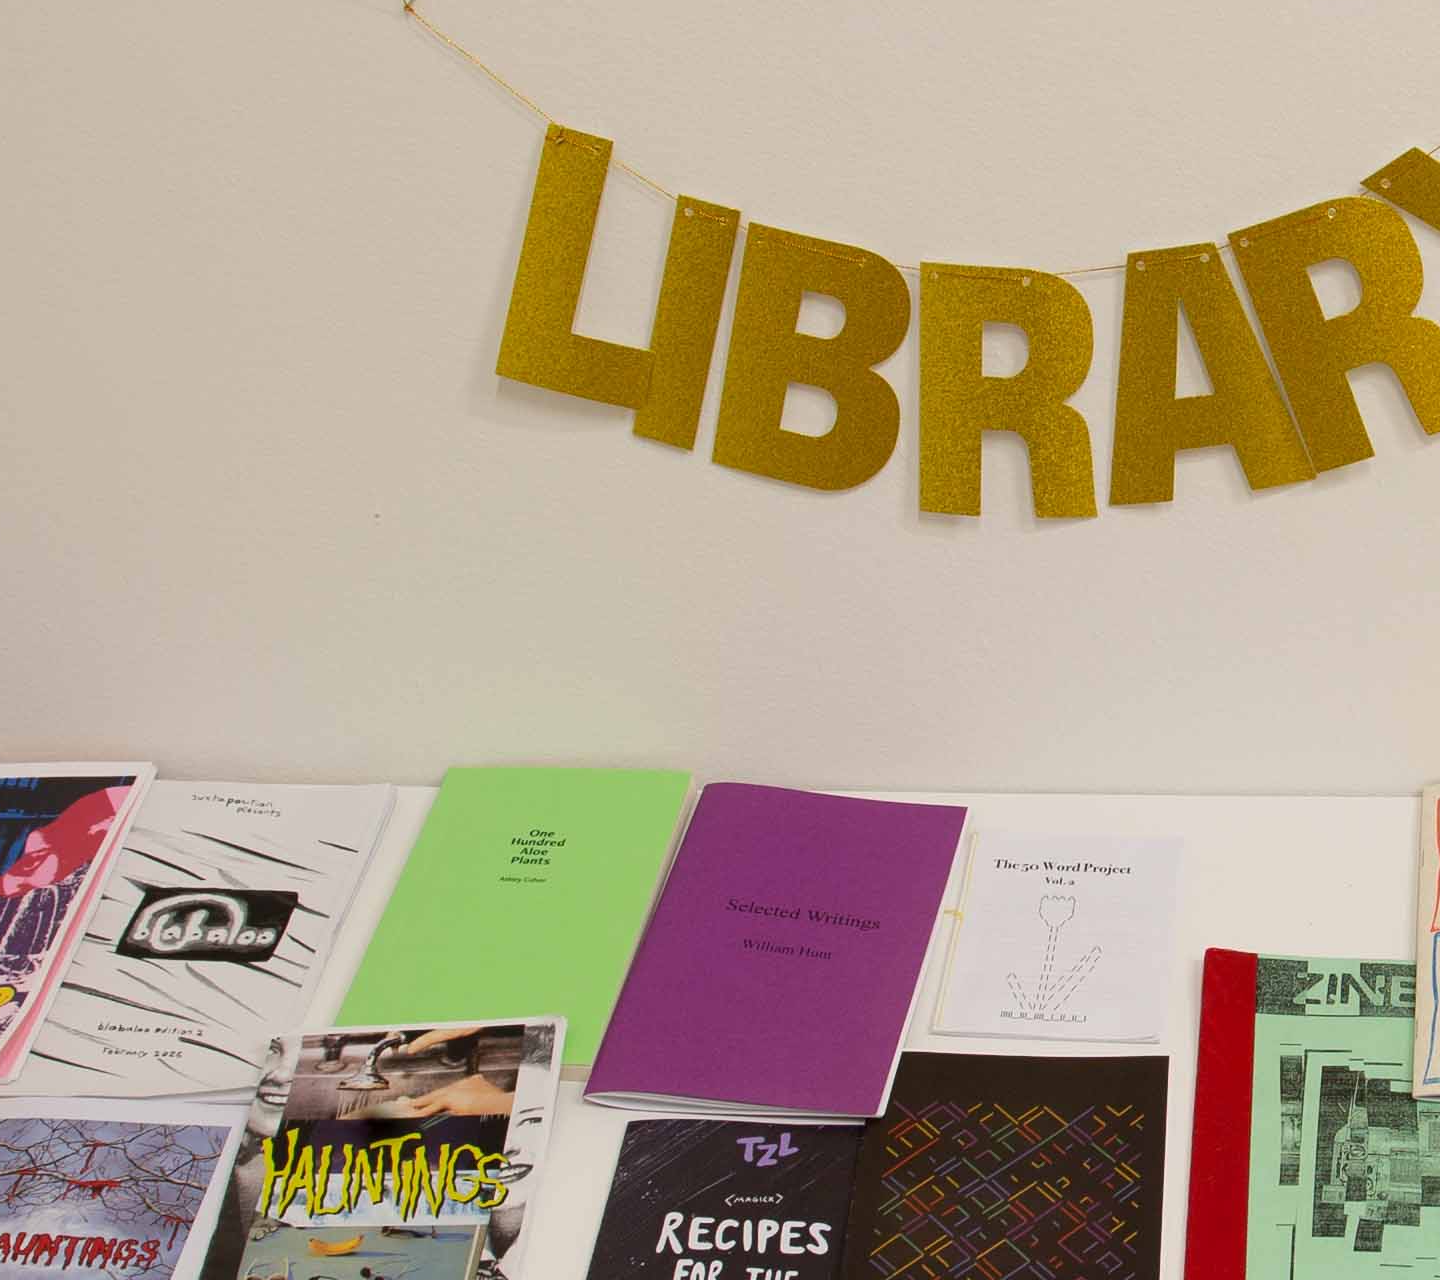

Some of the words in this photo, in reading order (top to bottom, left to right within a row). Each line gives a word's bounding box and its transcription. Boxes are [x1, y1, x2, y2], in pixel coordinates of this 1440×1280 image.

[511, 836, 567, 848] Hundred
[529, 828, 556, 838] One
[511, 855, 551, 866] Plants
[520, 846, 549, 856] Aloe
[994, 858, 1020, 871] The
[1021, 862, 1040, 873] 50
[1043, 861, 1081, 873] Word
[1083, 861, 1133, 877] Project
[1045, 876, 1066, 886] Vol.
[726, 897, 801, 921] Selected
[807, 908, 881, 932] Writings
[742, 937, 795, 957] William
[735, 1132, 801, 1168] TZL
[262, 1127, 511, 1223] HAUNTINGS
[655, 1211, 833, 1256] RECIPES
